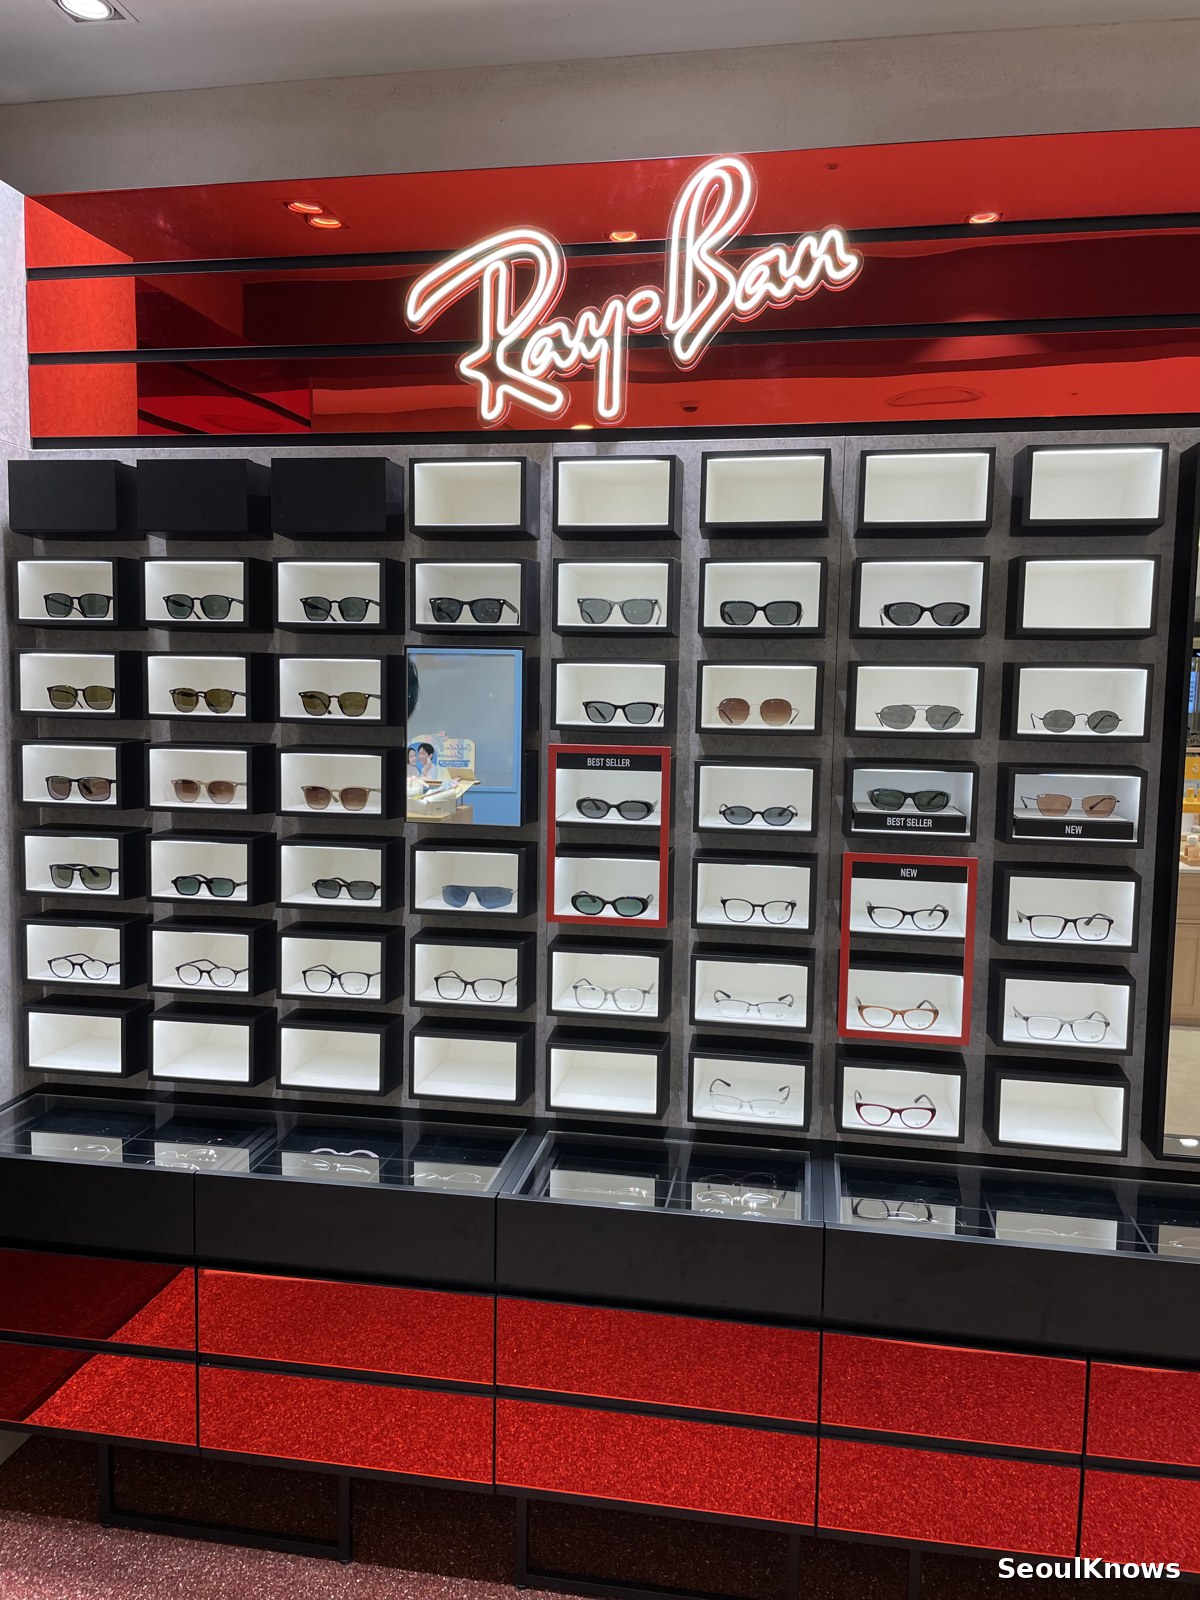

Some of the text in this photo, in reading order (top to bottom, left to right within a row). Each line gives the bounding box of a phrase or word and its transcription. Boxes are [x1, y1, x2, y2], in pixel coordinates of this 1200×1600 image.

[587, 757, 631, 767] BEST SELLER
[886, 817, 933, 828] BEST SELLER
[1065, 825, 1083, 835] NEW
[900, 868, 918, 878] NEW
